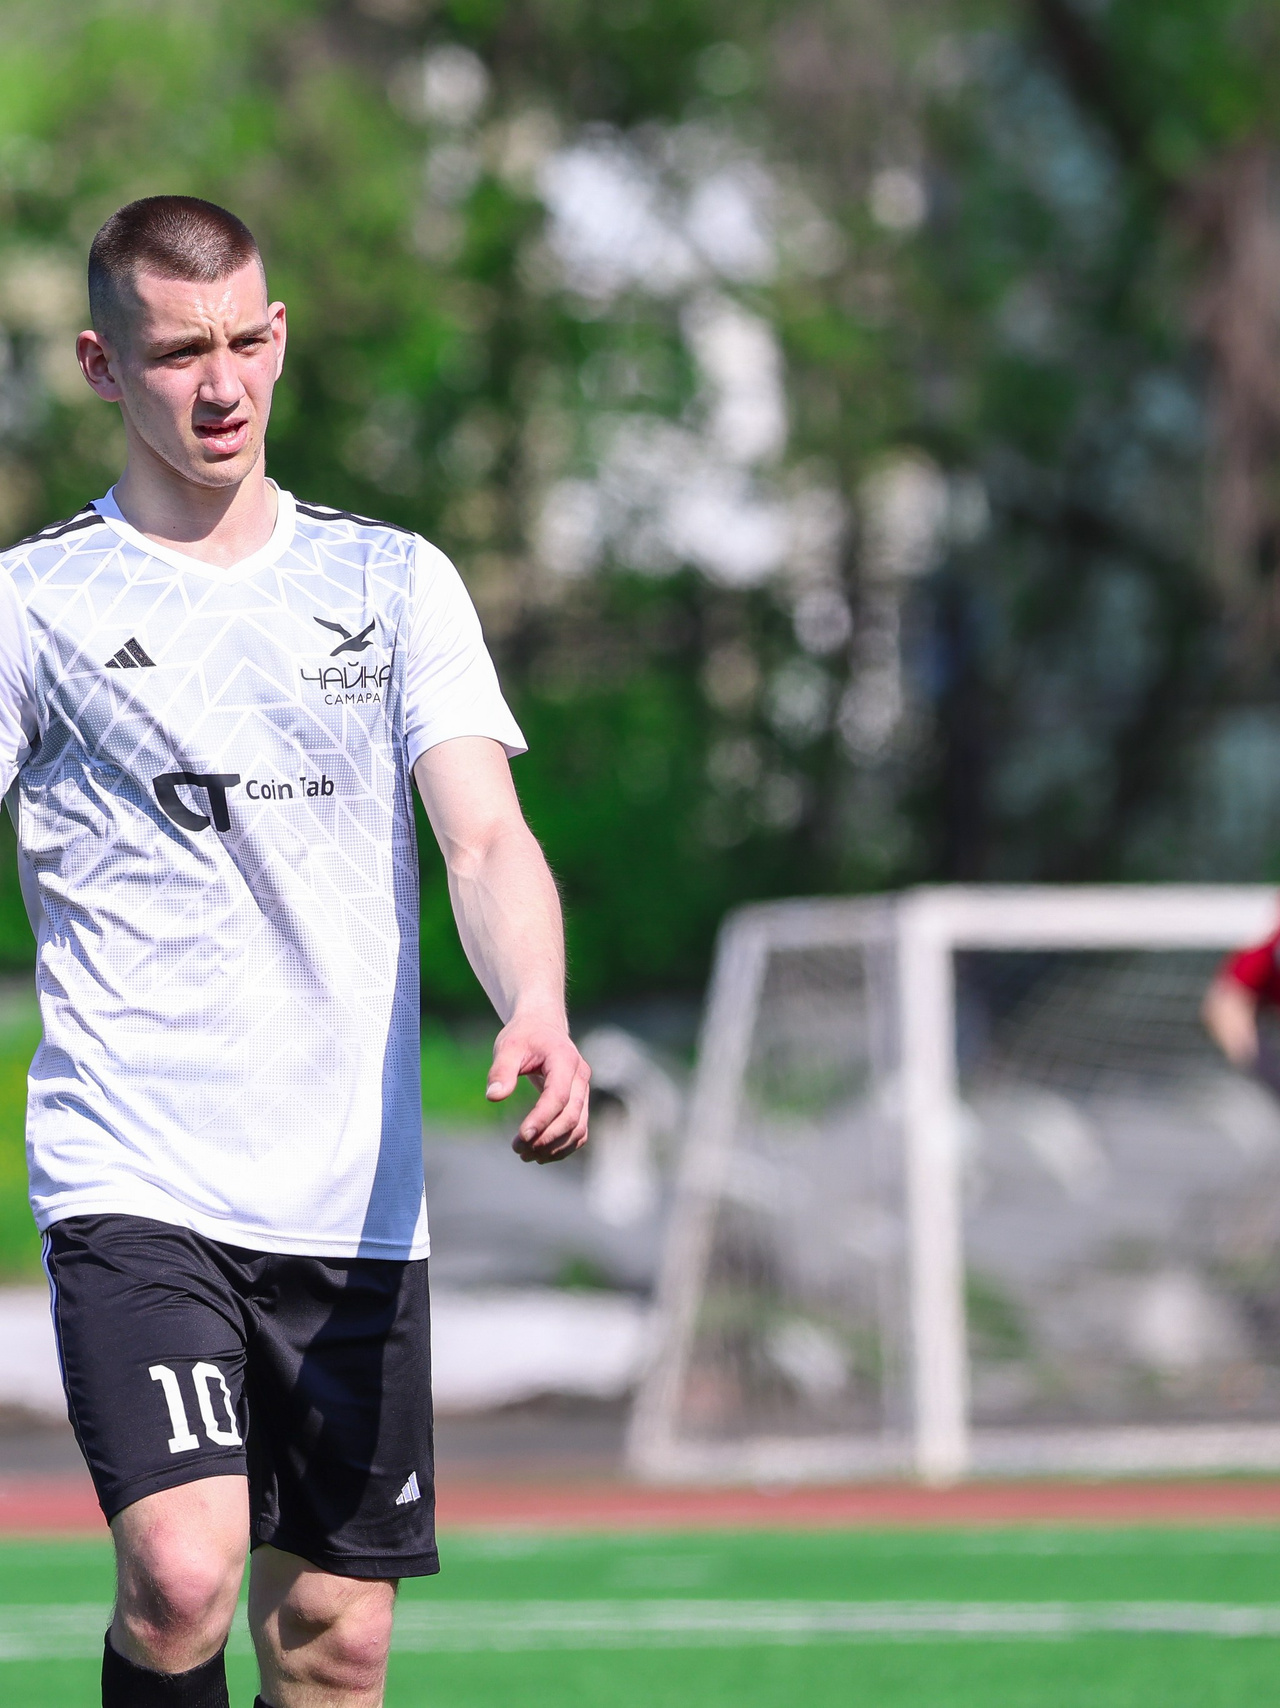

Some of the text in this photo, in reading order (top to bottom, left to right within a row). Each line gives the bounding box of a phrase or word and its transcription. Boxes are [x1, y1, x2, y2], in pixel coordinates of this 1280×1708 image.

[324, 693, 381, 706] САМАРА
[152, 771, 335, 833] CT Coin Tab
[148, 1361, 243, 1454] 10
